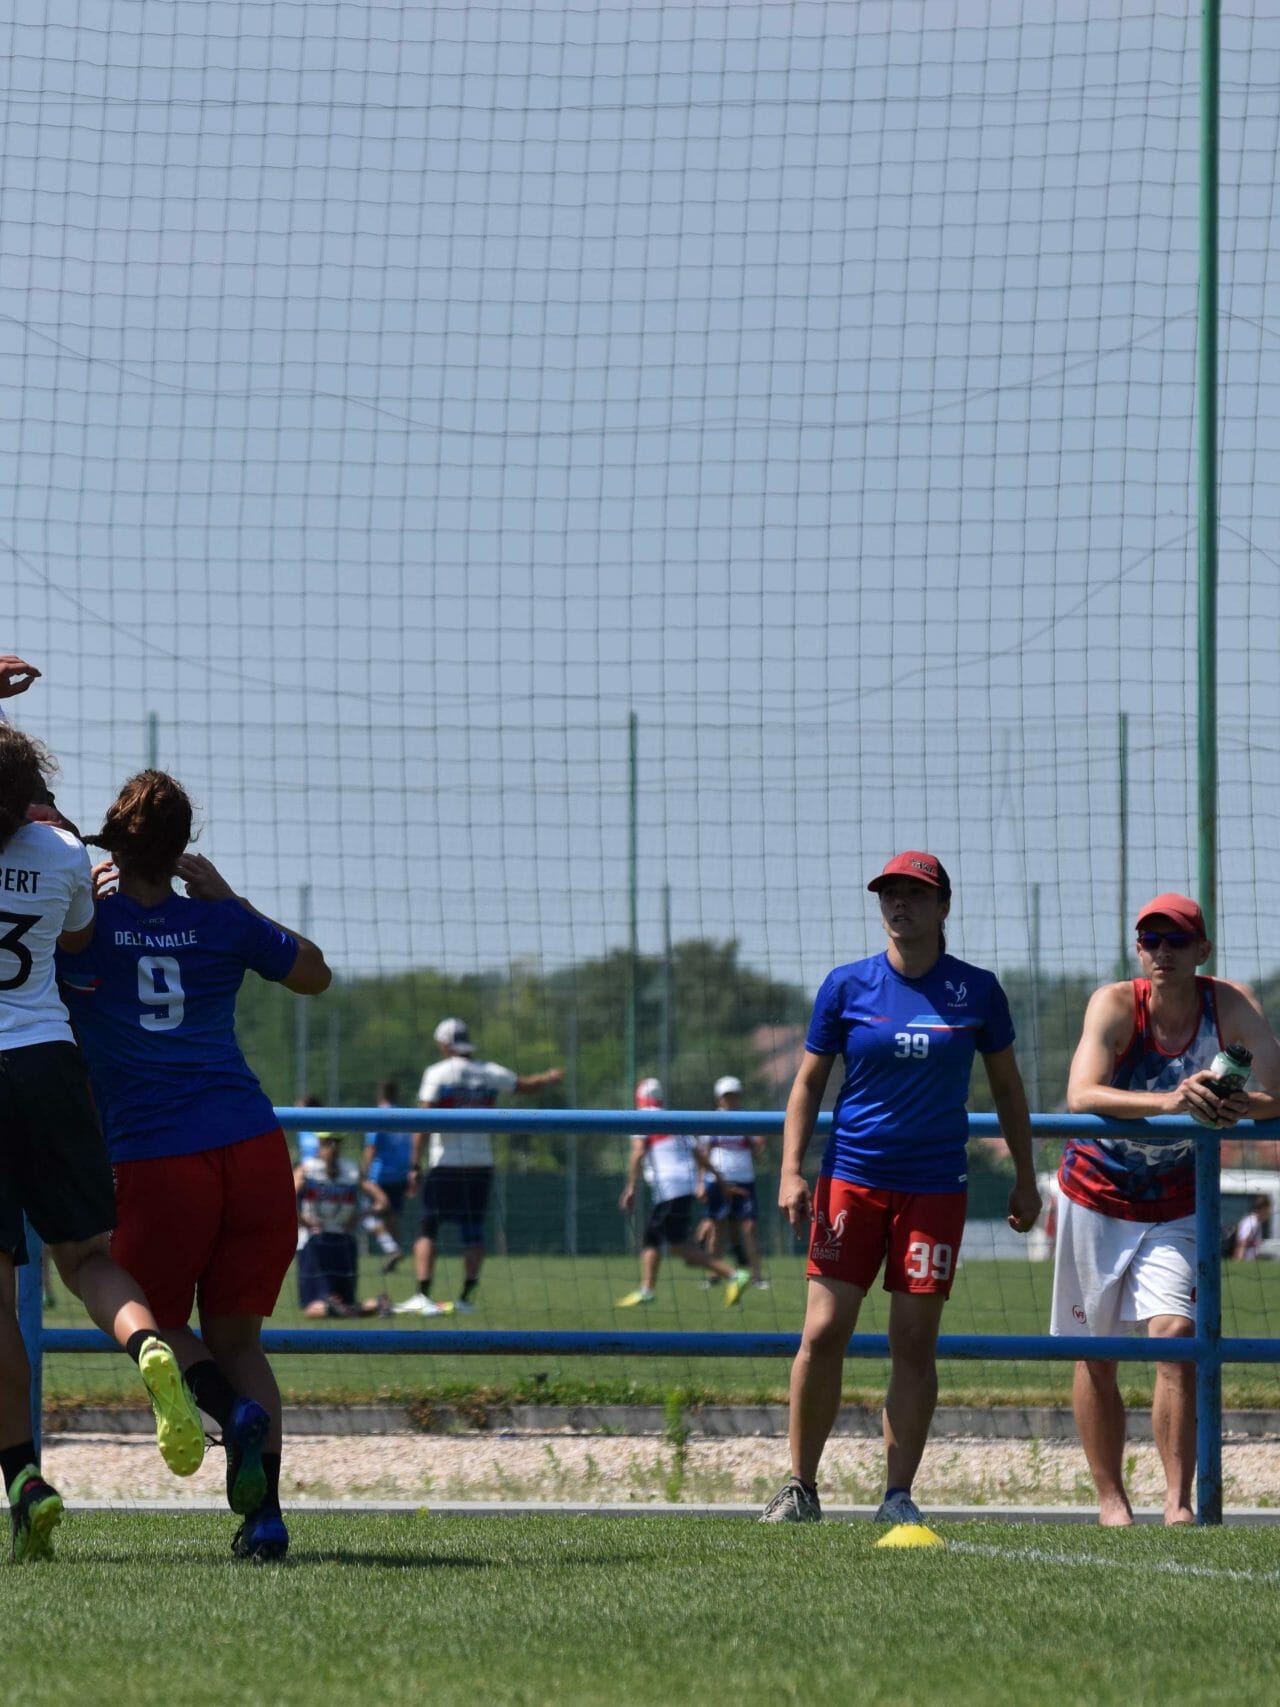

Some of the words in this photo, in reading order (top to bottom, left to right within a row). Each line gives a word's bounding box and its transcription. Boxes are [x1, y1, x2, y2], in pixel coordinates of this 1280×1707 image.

[137, 955, 186, 1032] 9
[894, 1032, 930, 1059] 39
[907, 1241, 953, 1281] 39
